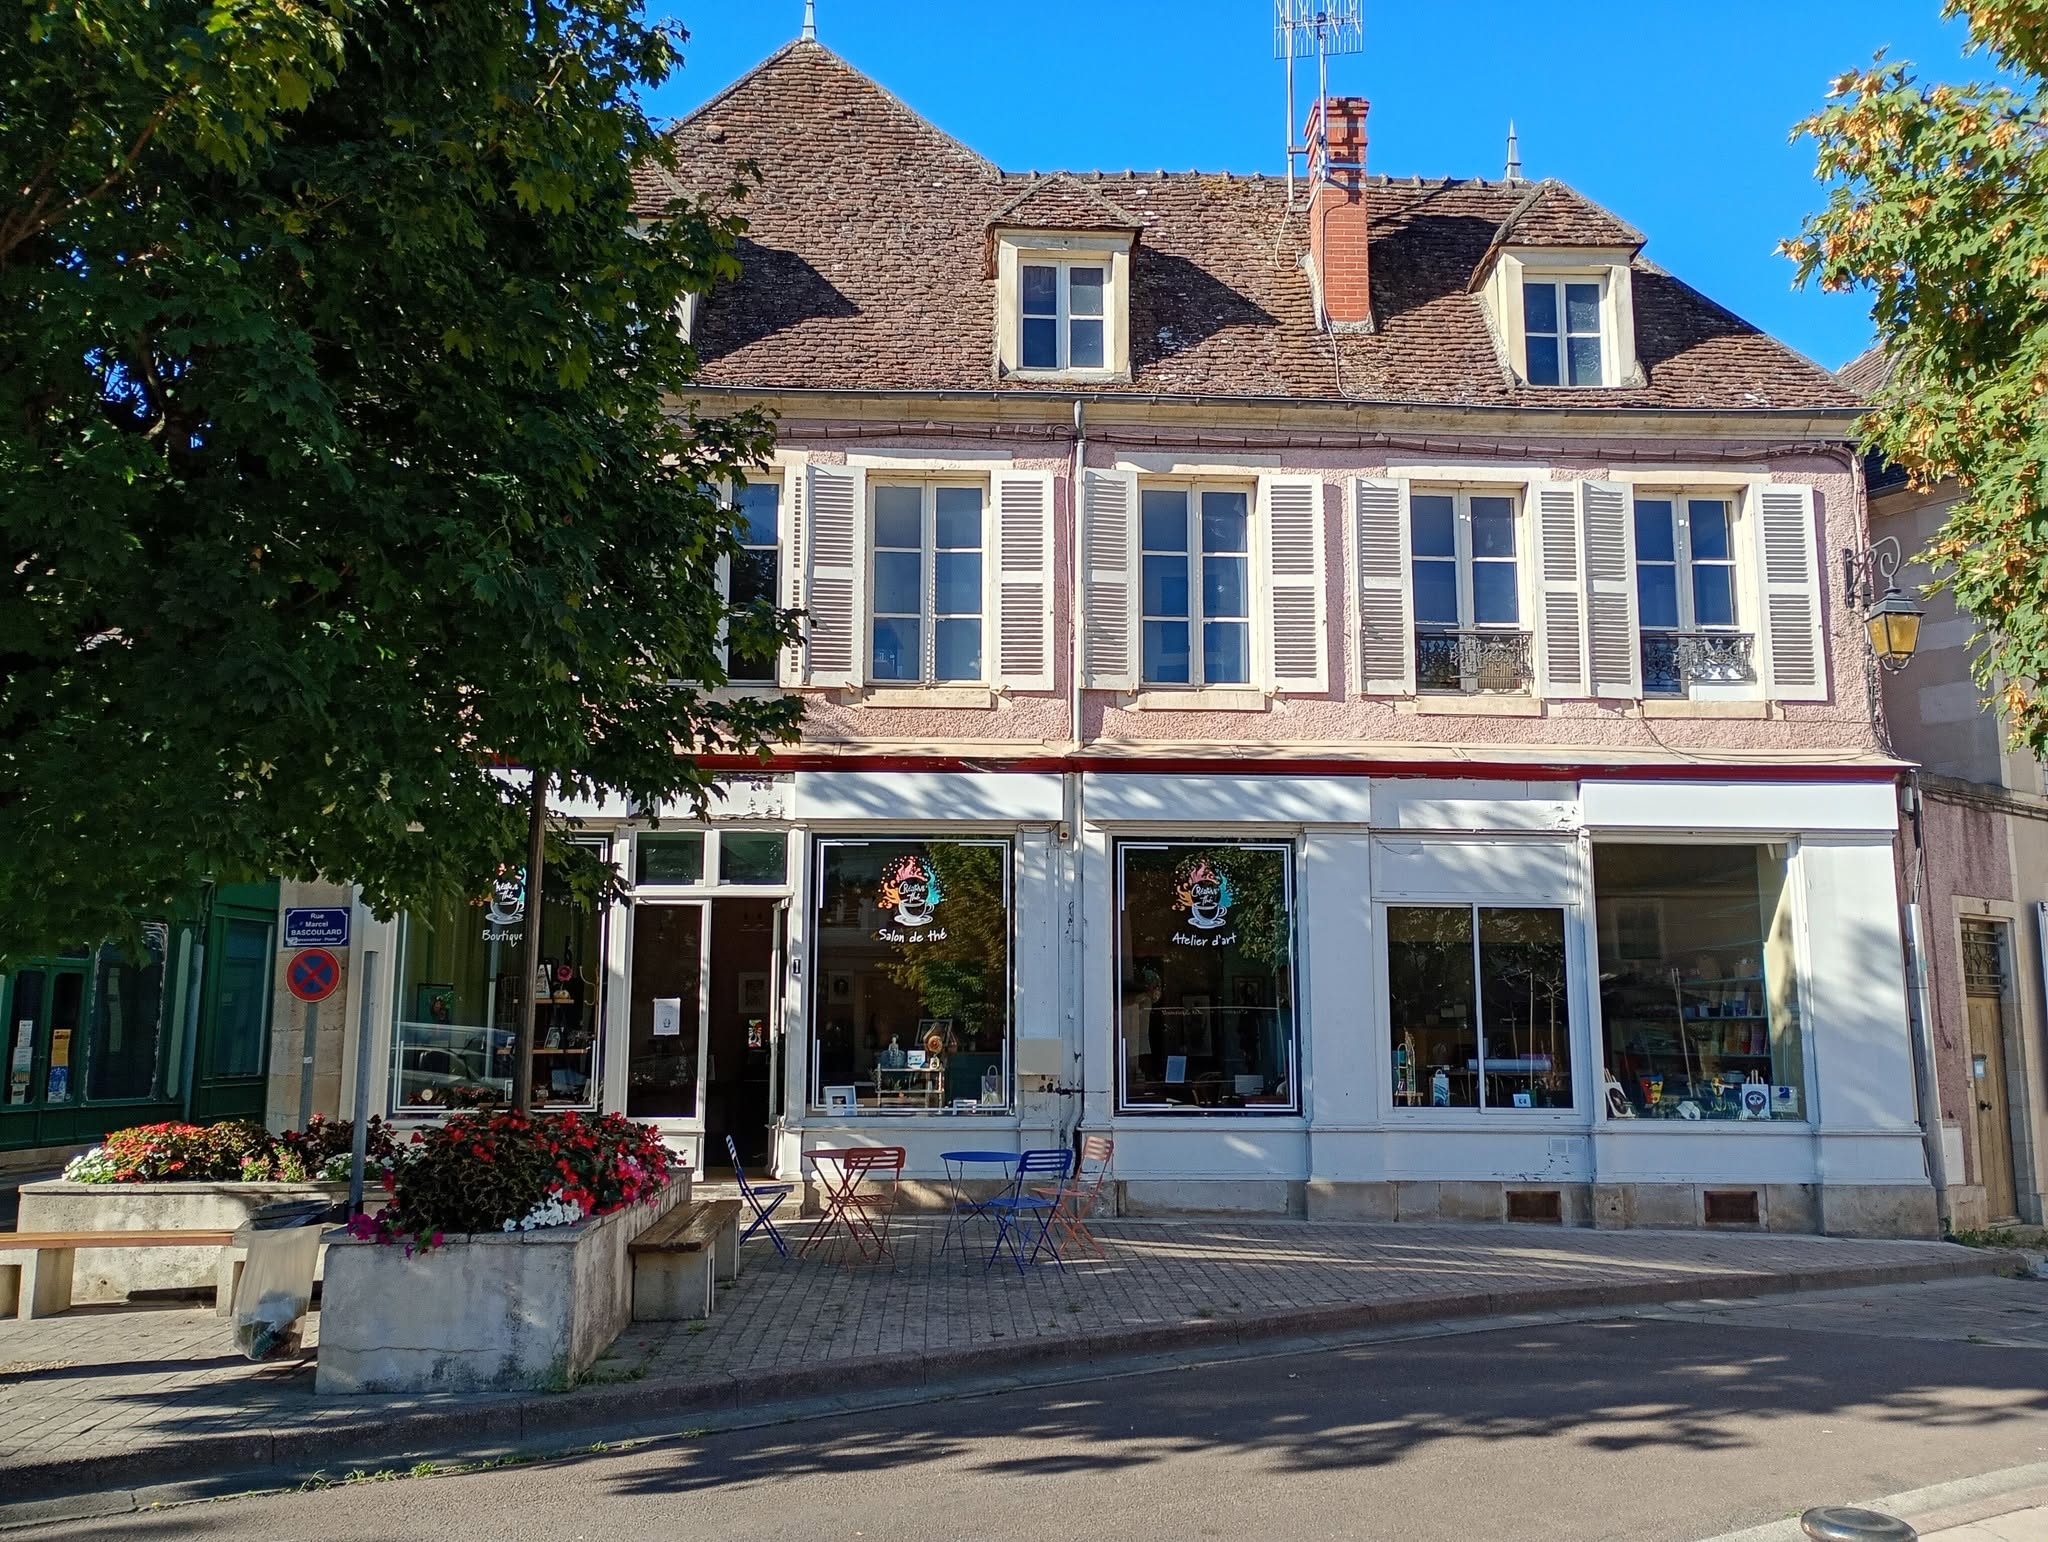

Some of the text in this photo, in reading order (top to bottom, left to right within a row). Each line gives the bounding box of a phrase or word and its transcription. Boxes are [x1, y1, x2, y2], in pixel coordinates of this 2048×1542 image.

[291, 928, 342, 936] BASCOULARD
[482, 929, 523, 948] Boutique
[878, 927, 948, 943] Salon de thé
[1172, 931, 1237, 947] Atelier d'art
